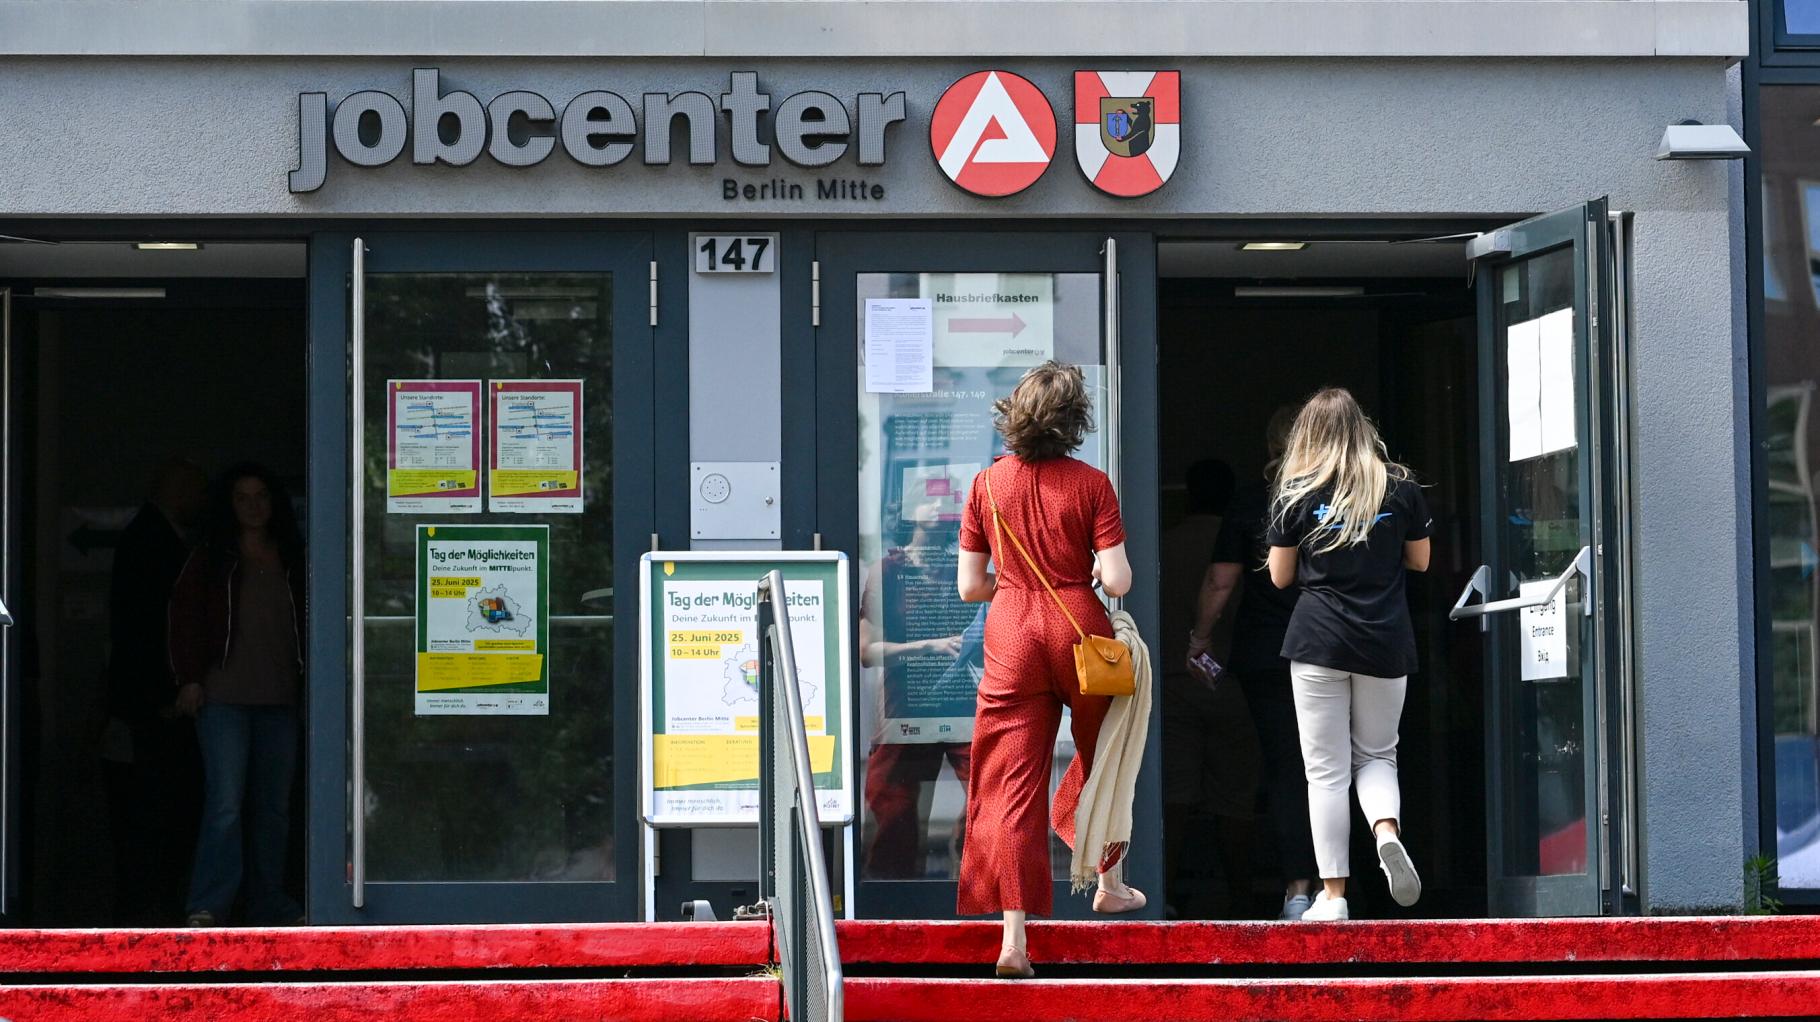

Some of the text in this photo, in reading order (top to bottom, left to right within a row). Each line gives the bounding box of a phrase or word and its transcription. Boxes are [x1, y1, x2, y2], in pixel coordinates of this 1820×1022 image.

[289, 67, 907, 194] jobcenter
[723, 178, 885, 201] Berlin Mitte
[700, 237, 770, 271] 147
[936, 293, 1040, 303] Hausbriefkasten
[430, 548, 535, 563] Tag der Möglichkeiten
[433, 564, 451, 572] Deine
[452, 564, 477, 572] Zukunft
[462, 578, 479, 586] 2025
[668, 591, 820, 611] Tag der Mögleiten
[672, 614, 698, 623] Deine
[701, 613, 737, 622] Zukunft
[740, 614, 752, 622] im
[672, 633, 740, 642] 25. Juni 2025
[1532, 625, 1554, 638] Entrance
